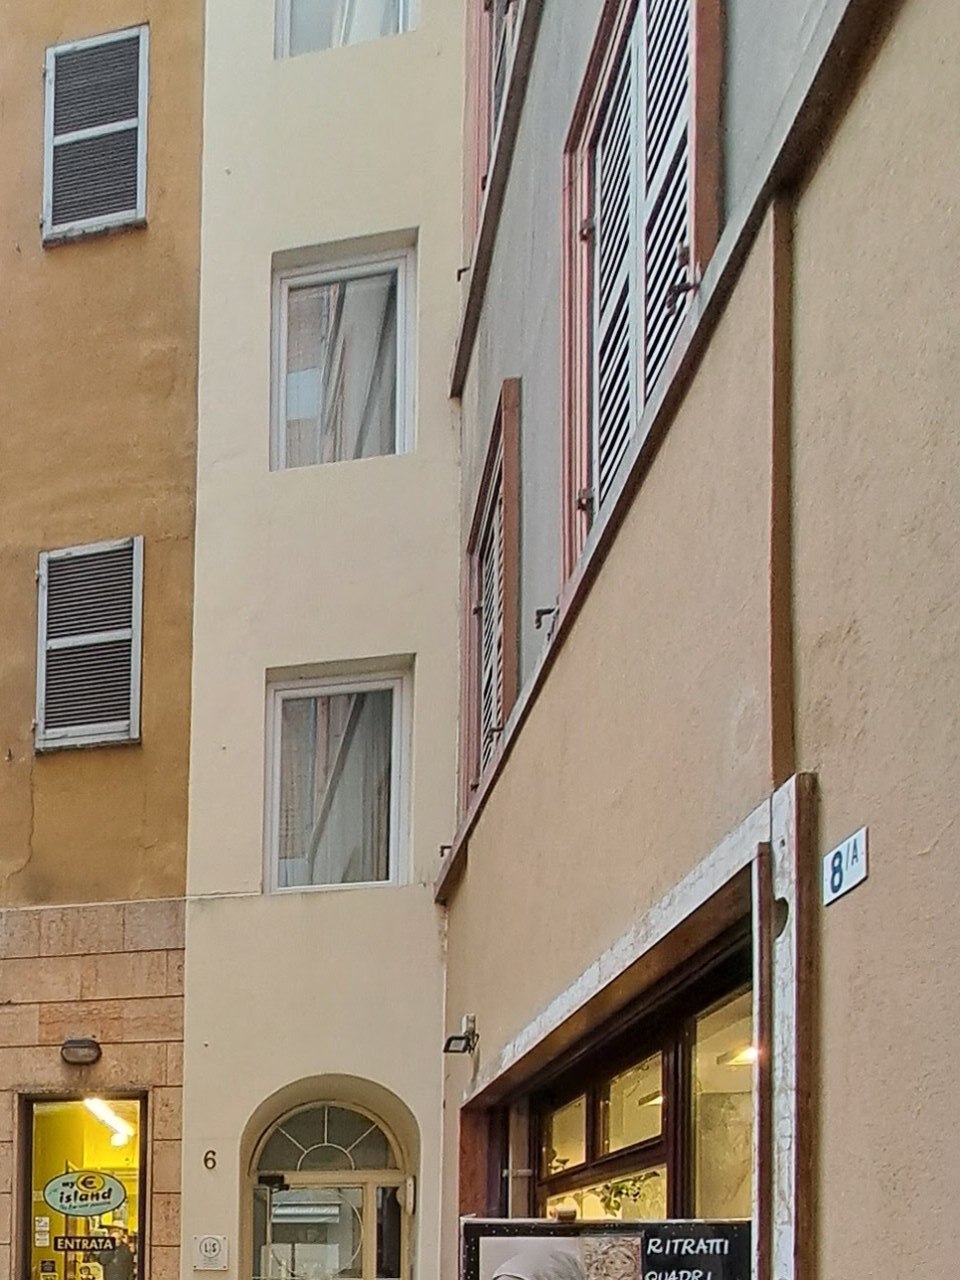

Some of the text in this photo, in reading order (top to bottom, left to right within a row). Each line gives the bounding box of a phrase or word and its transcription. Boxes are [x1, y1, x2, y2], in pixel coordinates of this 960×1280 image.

[830, 838, 859, 893] 8/A
[203, 1150, 216, 1170] 6
[59, 1187, 113, 1204] island
[57, 1238, 113, 1250] ENTRATA
[646, 1238, 730, 1256] RITRATTI
